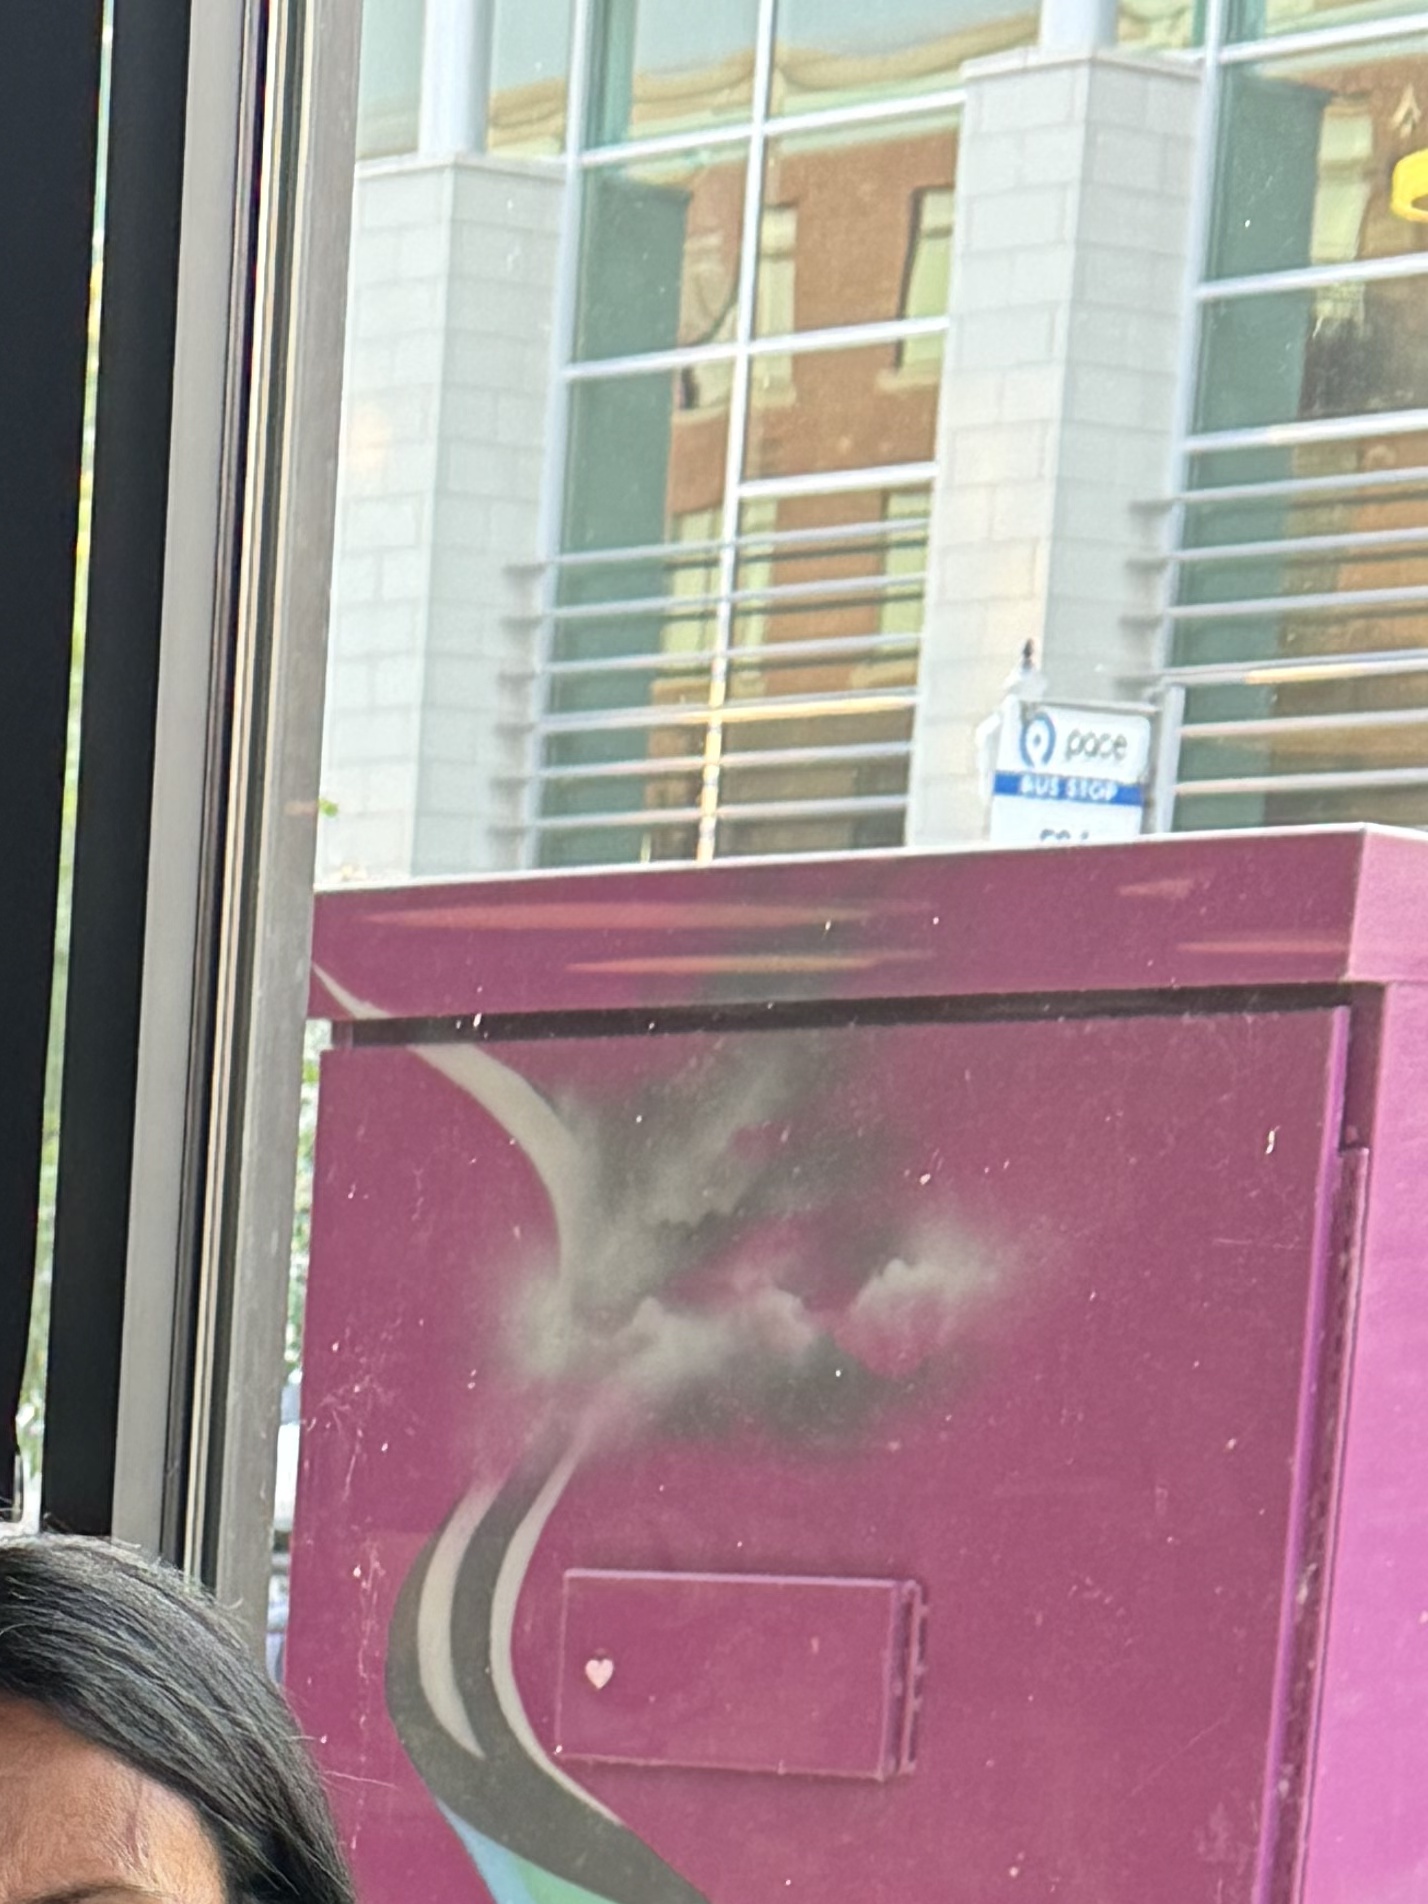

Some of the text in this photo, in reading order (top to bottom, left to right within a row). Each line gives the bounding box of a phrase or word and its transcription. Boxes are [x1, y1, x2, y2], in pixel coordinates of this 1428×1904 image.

[1065, 728, 1128, 762] pace
[1019, 773, 1119, 802] BUS STOP
